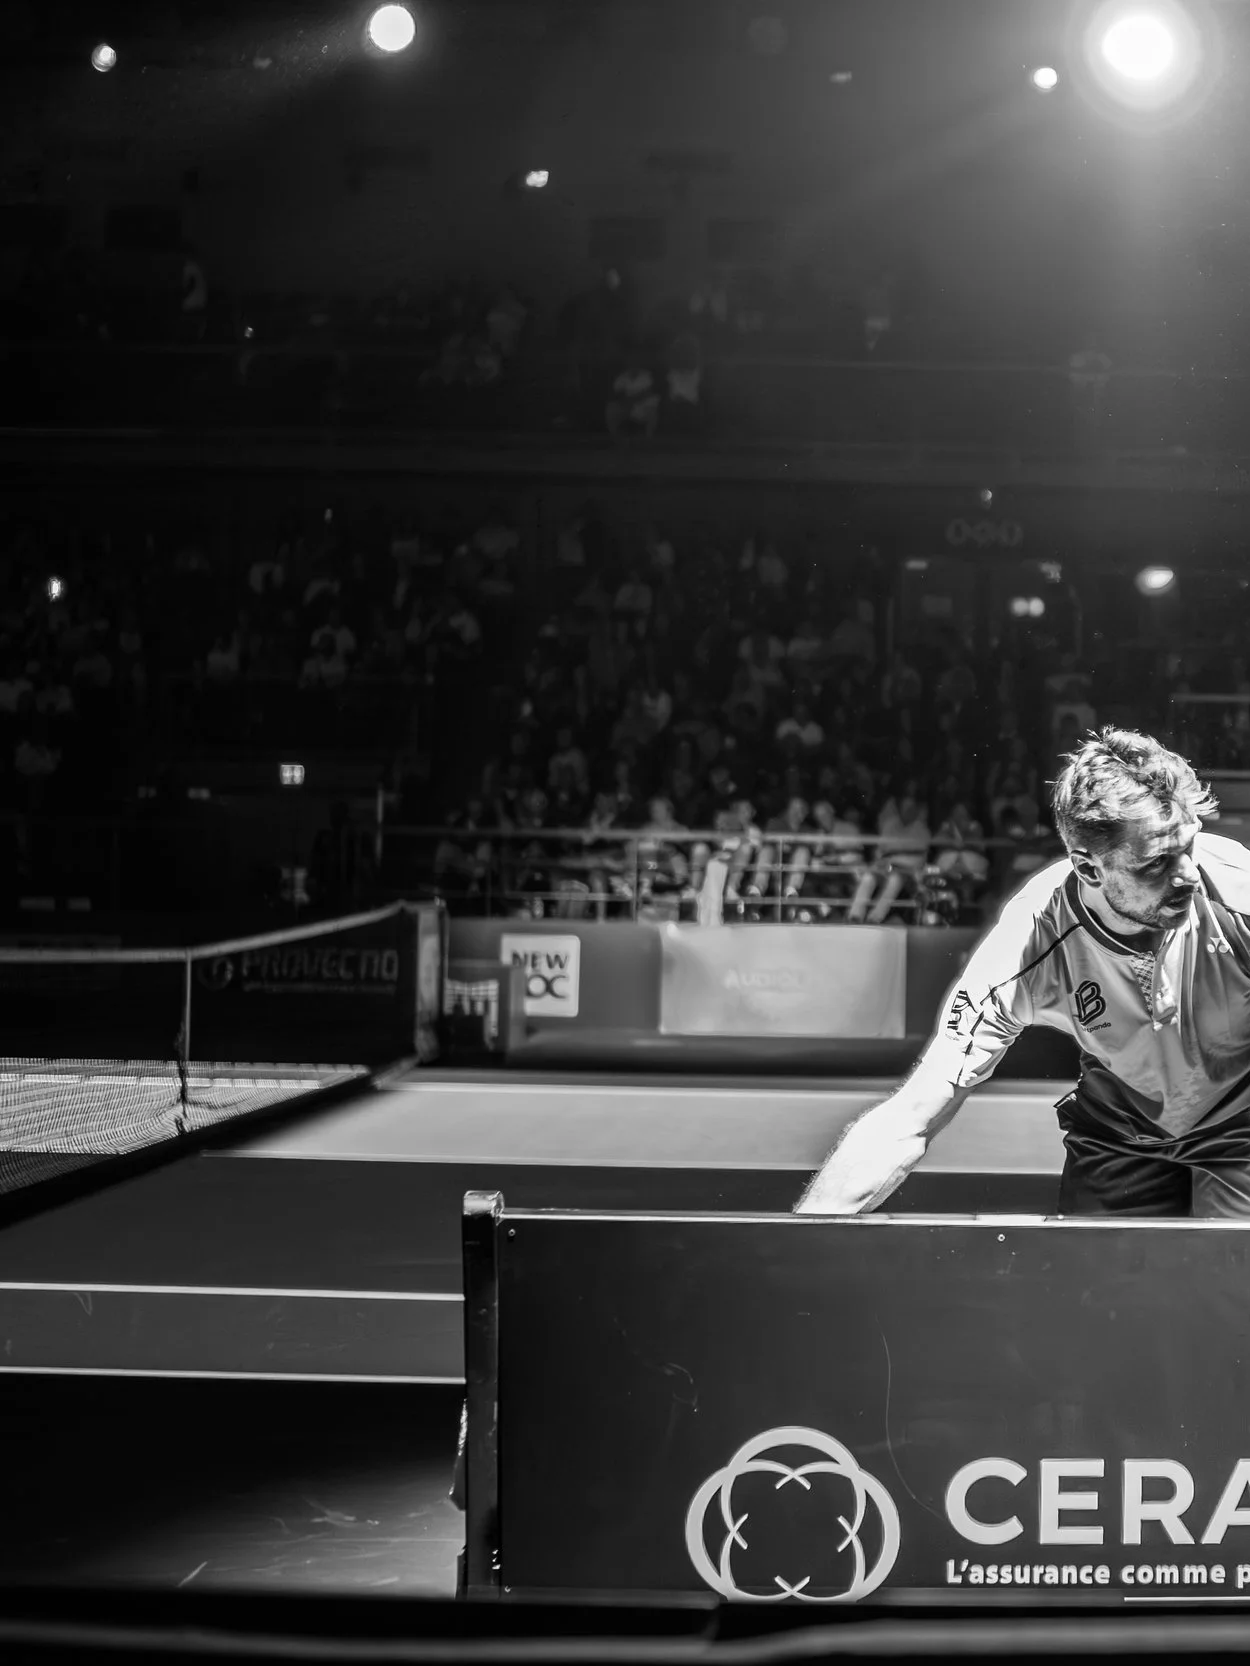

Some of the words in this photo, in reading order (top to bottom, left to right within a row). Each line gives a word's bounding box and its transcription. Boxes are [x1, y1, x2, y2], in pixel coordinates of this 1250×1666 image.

[512, 951, 568, 970] NEW
[525, 974, 568, 999] OC
[946, 1559, 1110, 1585] L'assurance
[1120, 1562, 1226, 1584] comme
